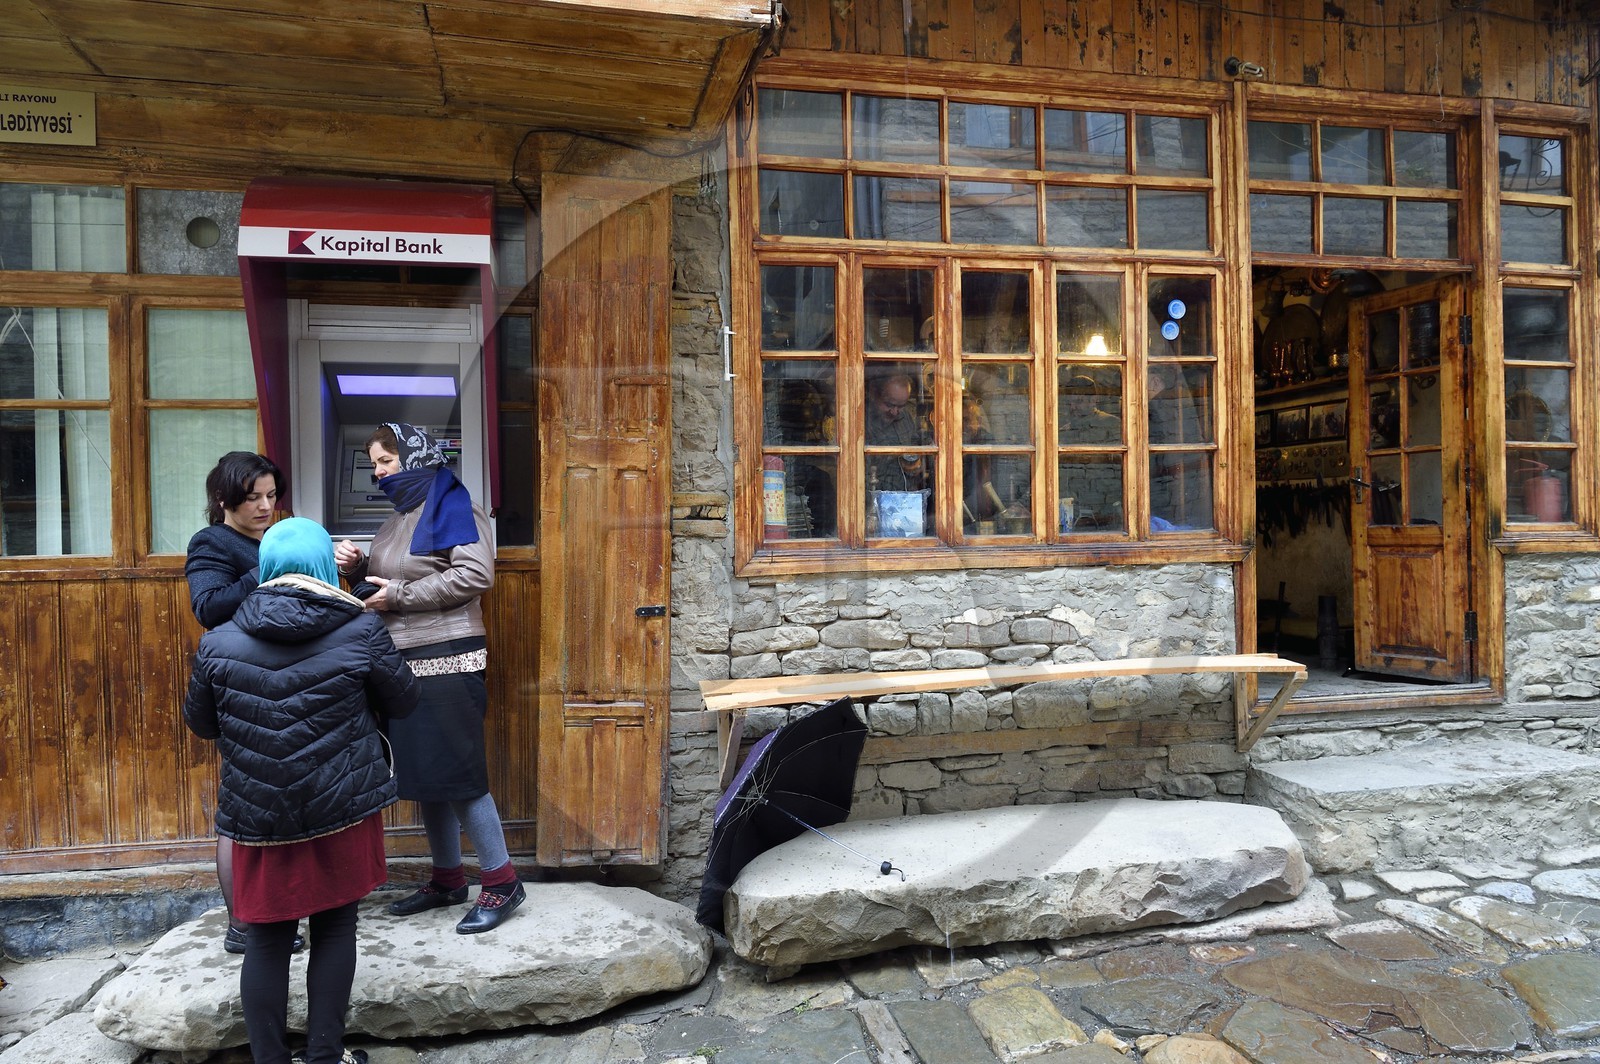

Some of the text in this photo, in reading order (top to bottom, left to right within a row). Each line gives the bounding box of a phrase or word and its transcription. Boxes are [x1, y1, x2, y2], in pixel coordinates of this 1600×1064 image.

[12, 94, 57, 104] RAYONU
[321, 236, 444, 256] Kapital Bank
